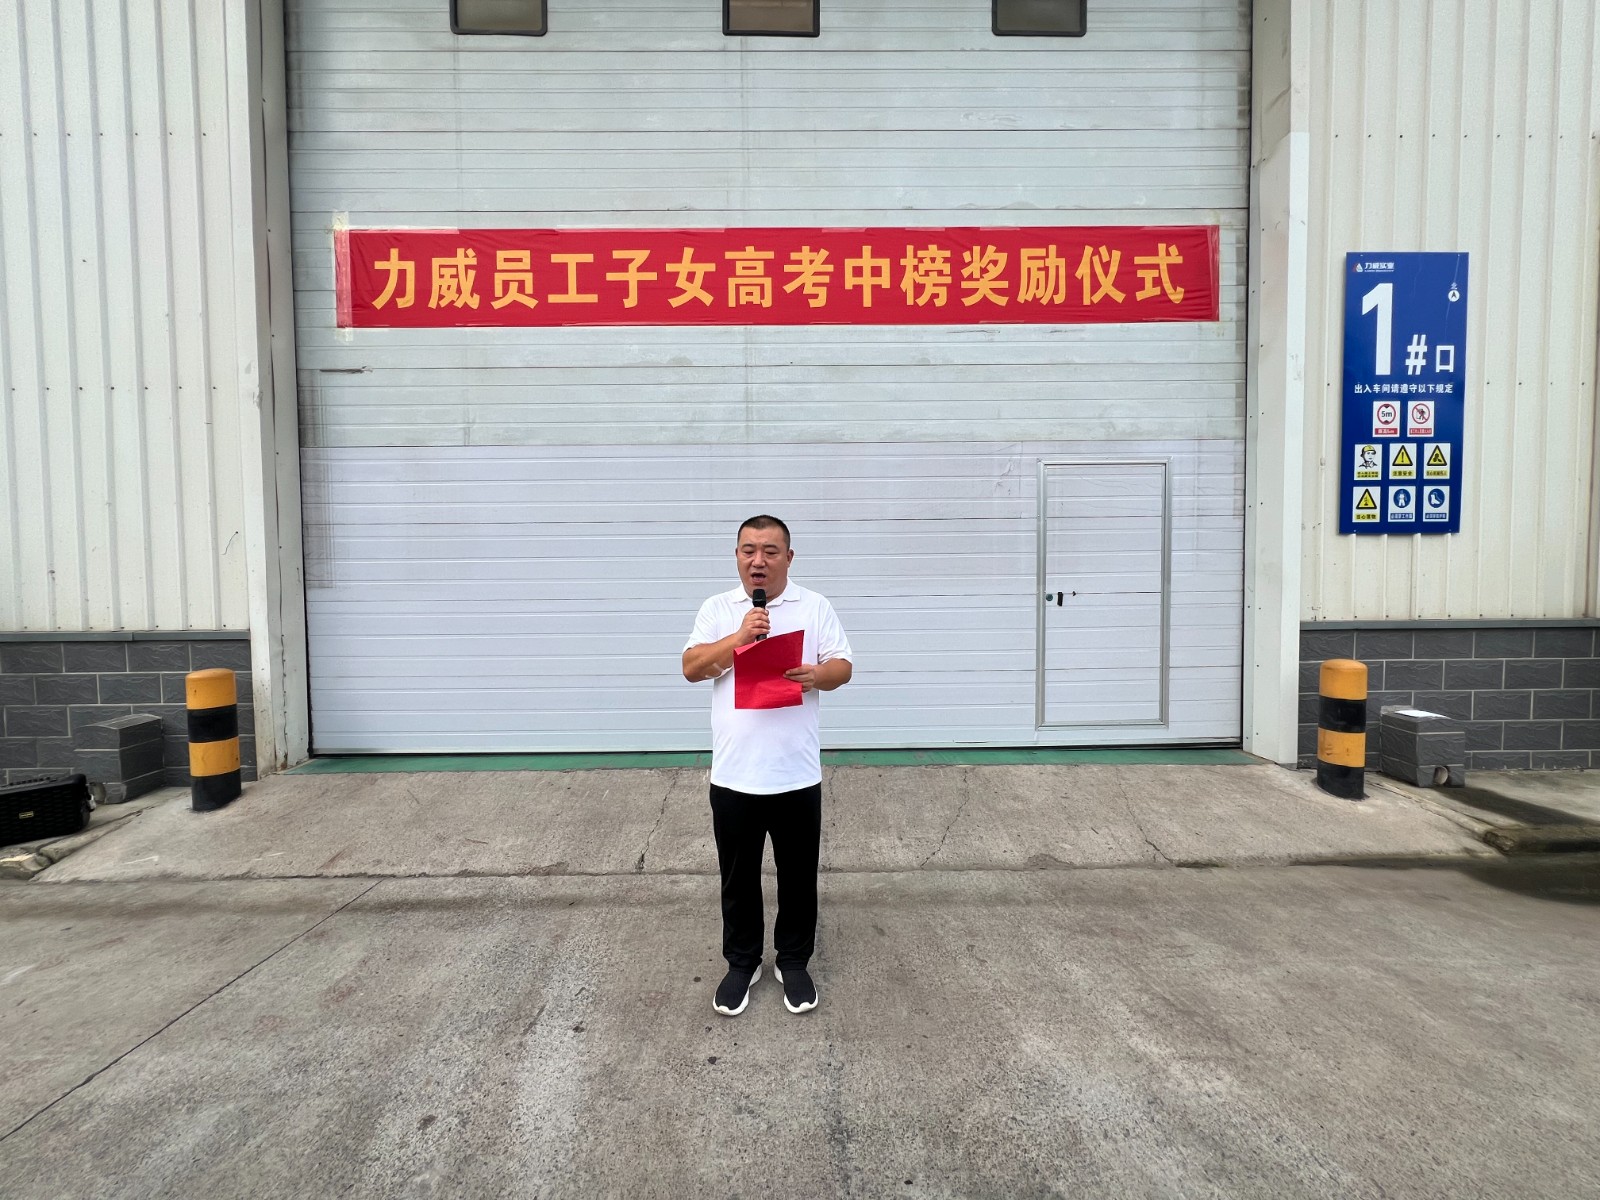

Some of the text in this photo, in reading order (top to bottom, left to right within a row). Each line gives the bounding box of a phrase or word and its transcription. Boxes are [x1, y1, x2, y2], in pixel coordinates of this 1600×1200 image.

[372, 243, 1185, 310] 力威员工子女高考中榜奖励仪式
[1355, 384, 1453, 393] 出入车间请遵守以下规定
